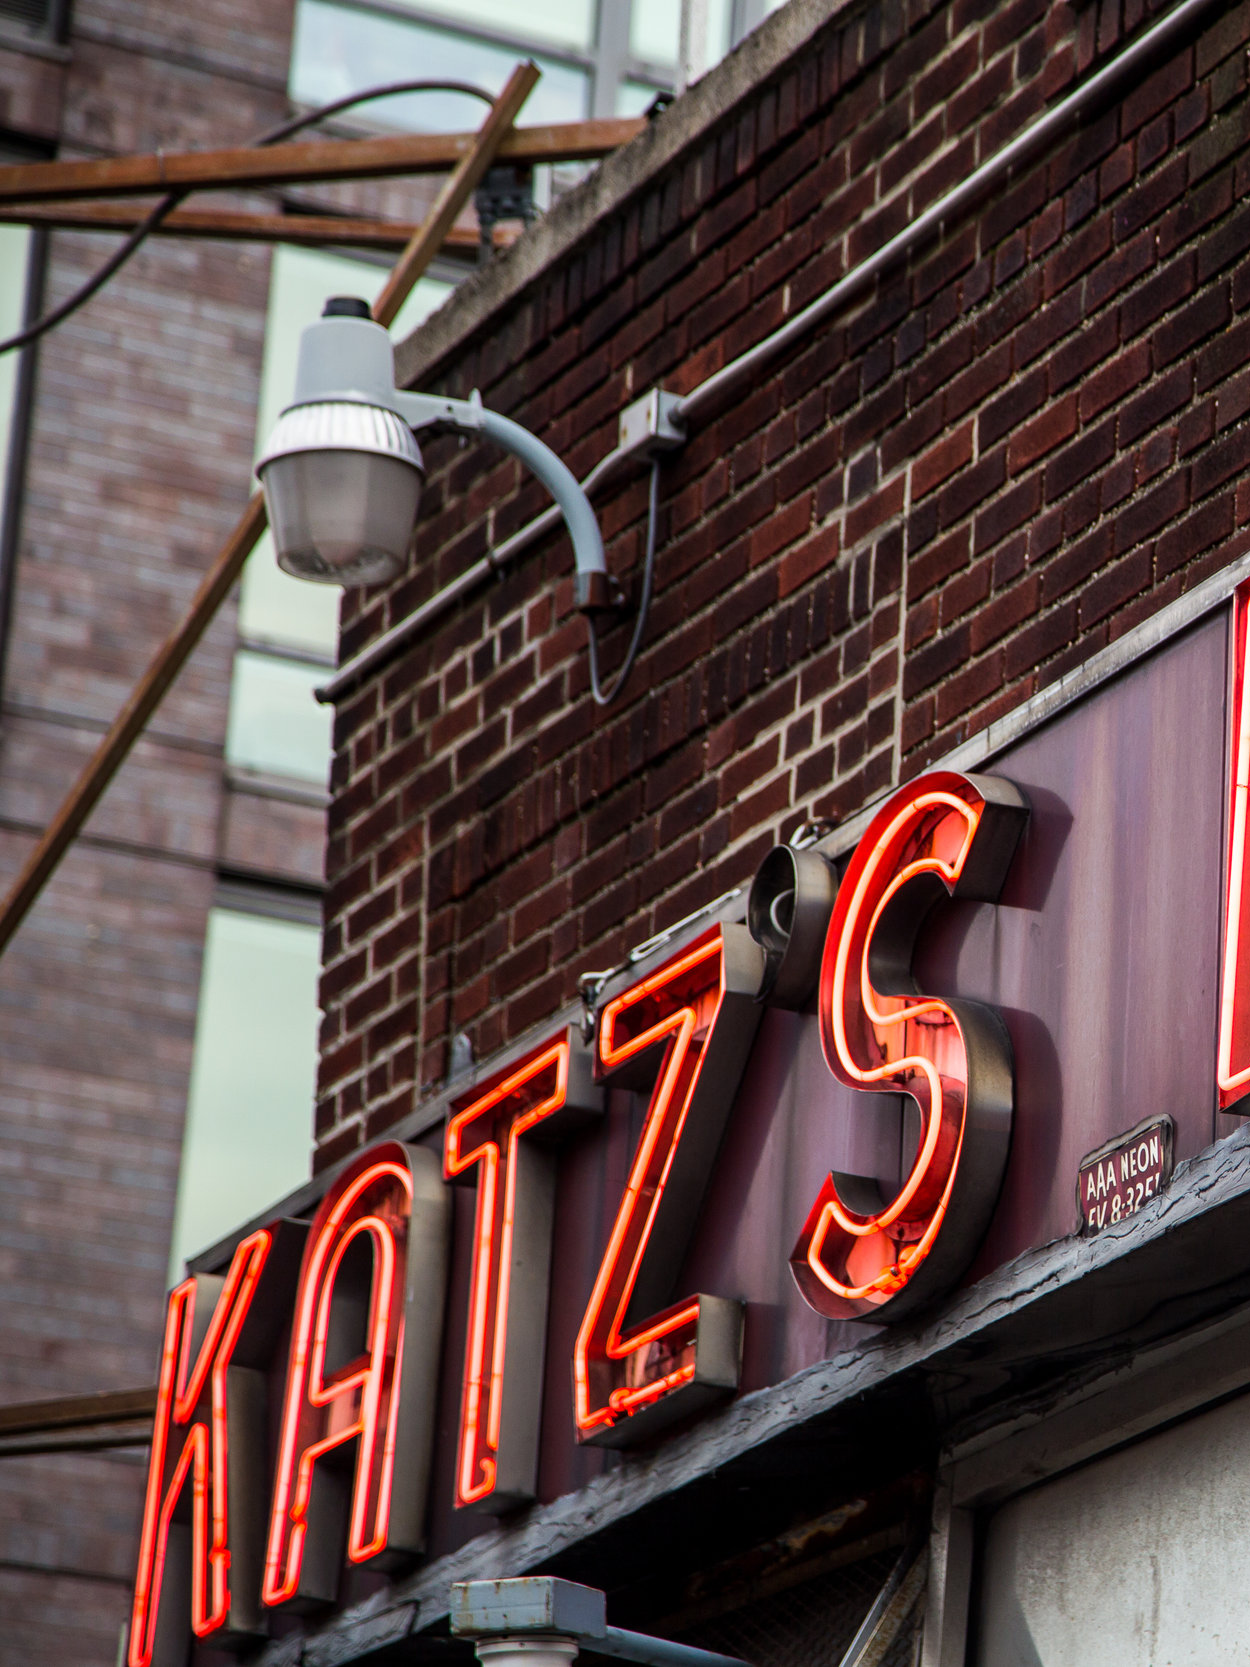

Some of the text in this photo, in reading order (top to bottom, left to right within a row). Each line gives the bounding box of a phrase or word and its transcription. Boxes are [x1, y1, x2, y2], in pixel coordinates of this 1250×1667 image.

[127, 769, 1015, 1667] KATZ'S
[1086, 1135, 1160, 1201] AAA NEON
